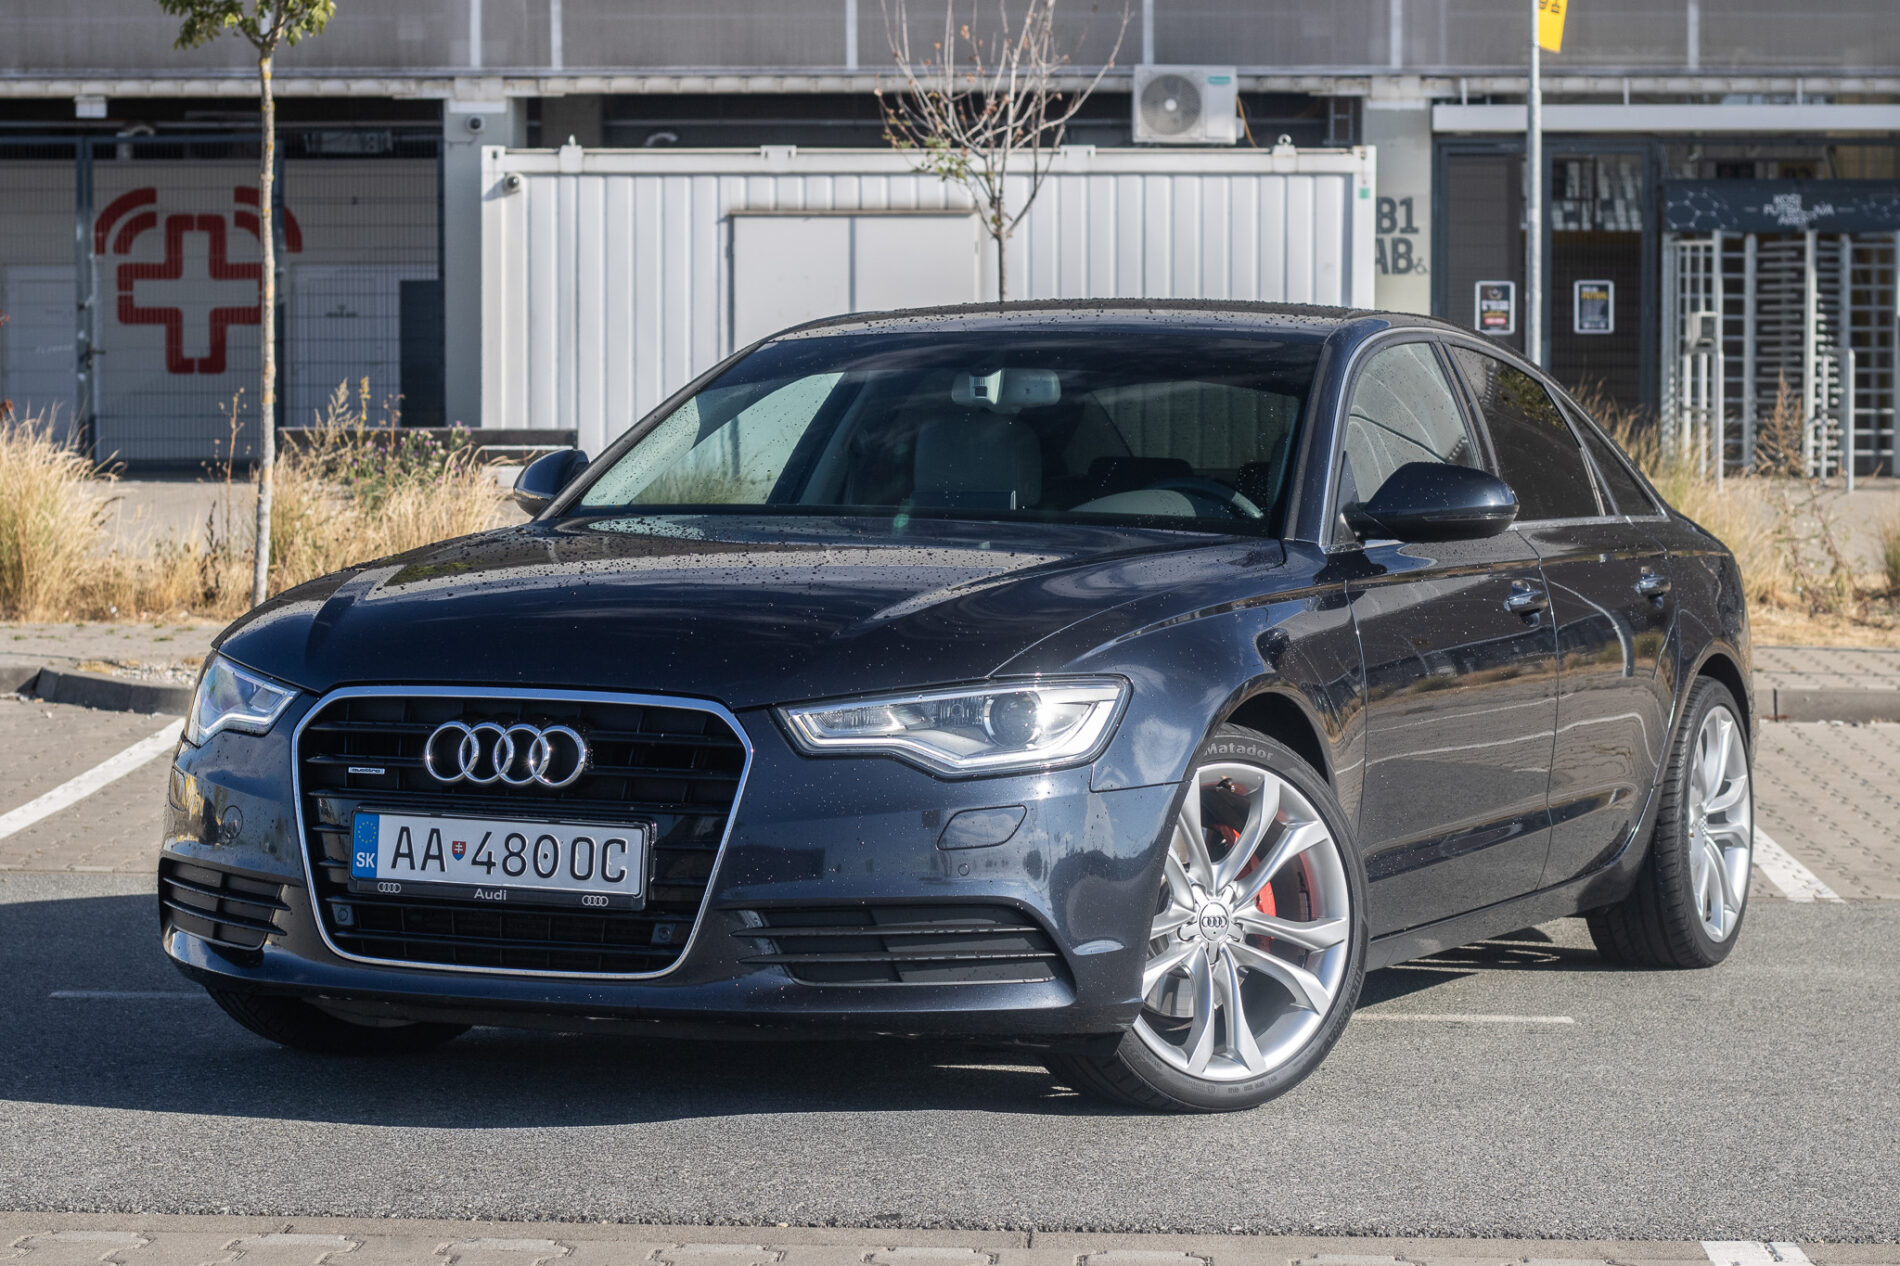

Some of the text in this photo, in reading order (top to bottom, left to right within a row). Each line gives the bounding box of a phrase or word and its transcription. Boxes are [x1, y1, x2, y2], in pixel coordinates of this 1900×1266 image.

[1376, 196, 1419, 234] B1
[1204, 742, 1274, 760] Matador
[391, 826, 447, 873] AA
[355, 852, 375, 869] SK
[474, 888, 507, 901] Audi
